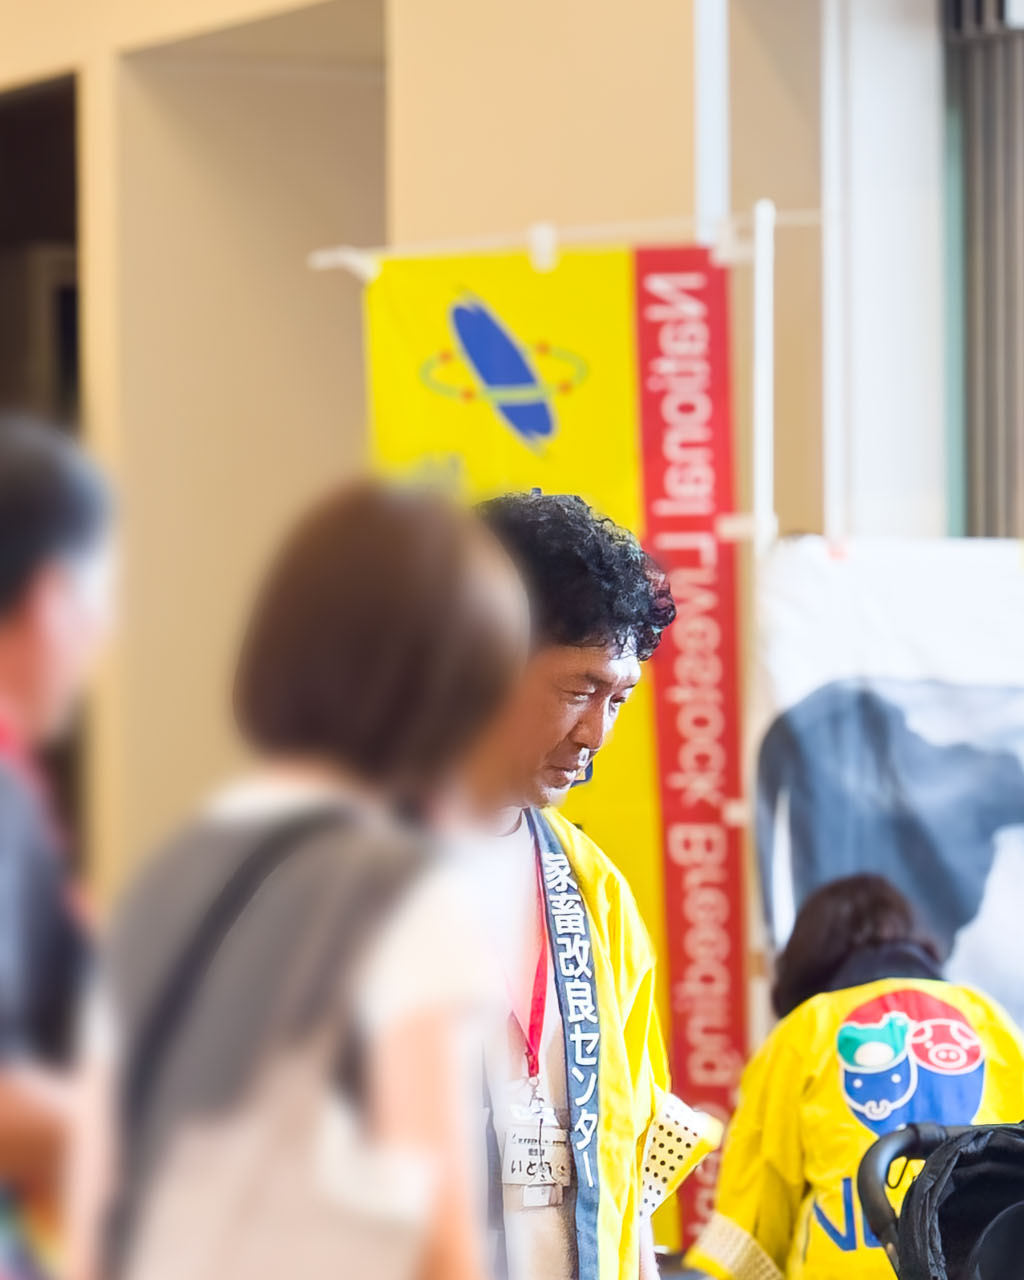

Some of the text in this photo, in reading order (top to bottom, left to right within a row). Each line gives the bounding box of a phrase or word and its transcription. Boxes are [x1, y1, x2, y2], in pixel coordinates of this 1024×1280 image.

[545, 852, 599, 1189] 家畜改良センター
